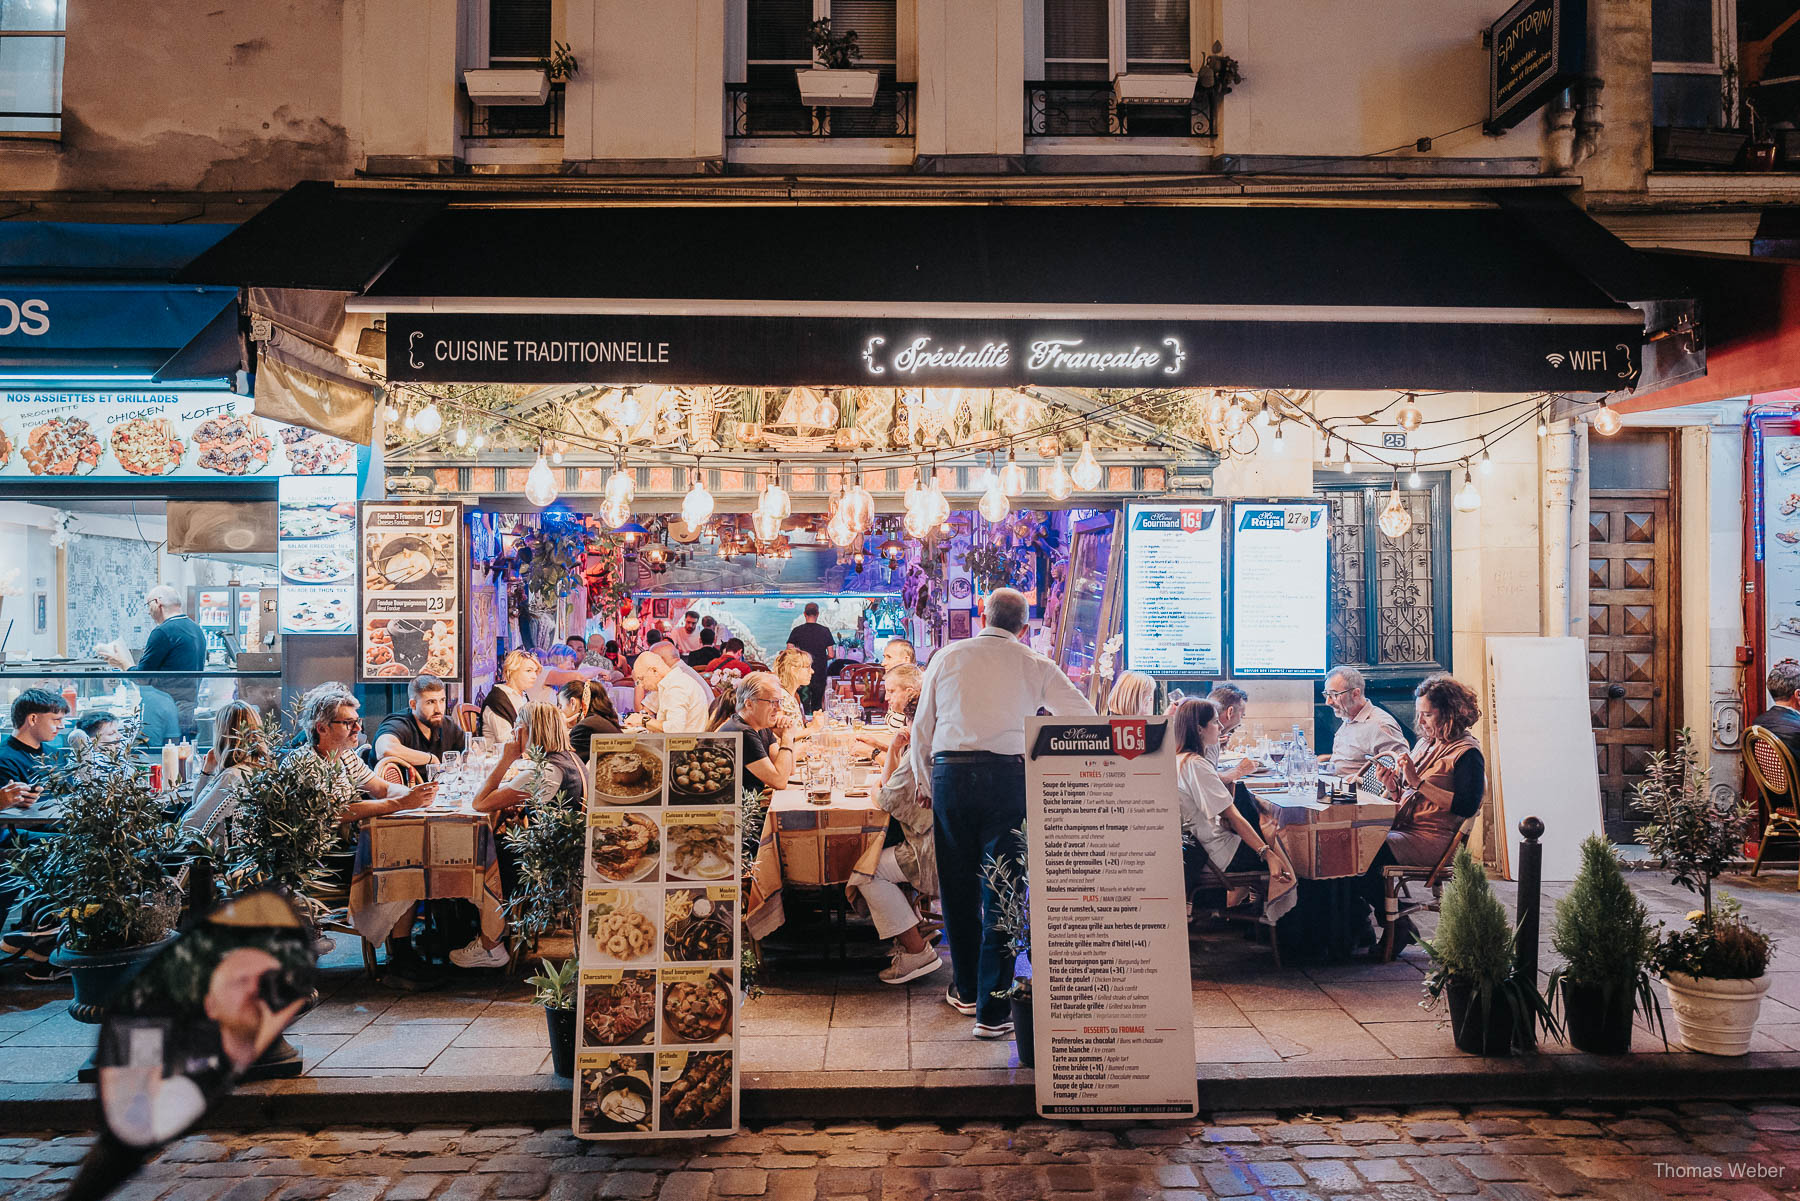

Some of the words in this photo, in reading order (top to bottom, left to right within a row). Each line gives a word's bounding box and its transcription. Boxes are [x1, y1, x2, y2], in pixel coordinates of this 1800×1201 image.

[1497, 7, 1552, 67] SANTORINI
[434, 340, 508, 362] CUISINE
[513, 341, 670, 363] TRADITIONNELLE
[895, 337, 1010, 373] Spécialité
[1028, 339, 1161, 372] Française
[1568, 350, 1607, 371] WIFI
[7, 394, 31, 403] NOS
[34, 393, 95, 404] ASSIETTES
[99, 394, 113, 403] ET
[116, 393, 179, 404] GRILLADES
[106, 405, 165, 424] CHICKEN
[181, 402, 236, 421] KOFTE
[1386, 434, 1404, 447] 25
[426, 509, 442, 524] 19
[1182, 512, 1195, 528] 16
[1288, 512, 1302, 524] 27
[1142, 519, 1180, 528] Gourmand
[1251, 518, 1284, 528] Royal
[428, 597, 444, 610] 23
[1062, 728, 1098, 740] Menu
[1114, 726, 1136, 750] 16
[1136, 726, 1142, 738] €
[1050, 738, 1110, 750] Gourmand
[1075, 940, 1091, 948] grillée
[1074, 994, 1093, 1002] grillées
[1087, 1002, 1104, 1011] grillée
[1079, 1082, 1093, 1090] glace
[1054, 1091, 1077, 1100] Fromage
